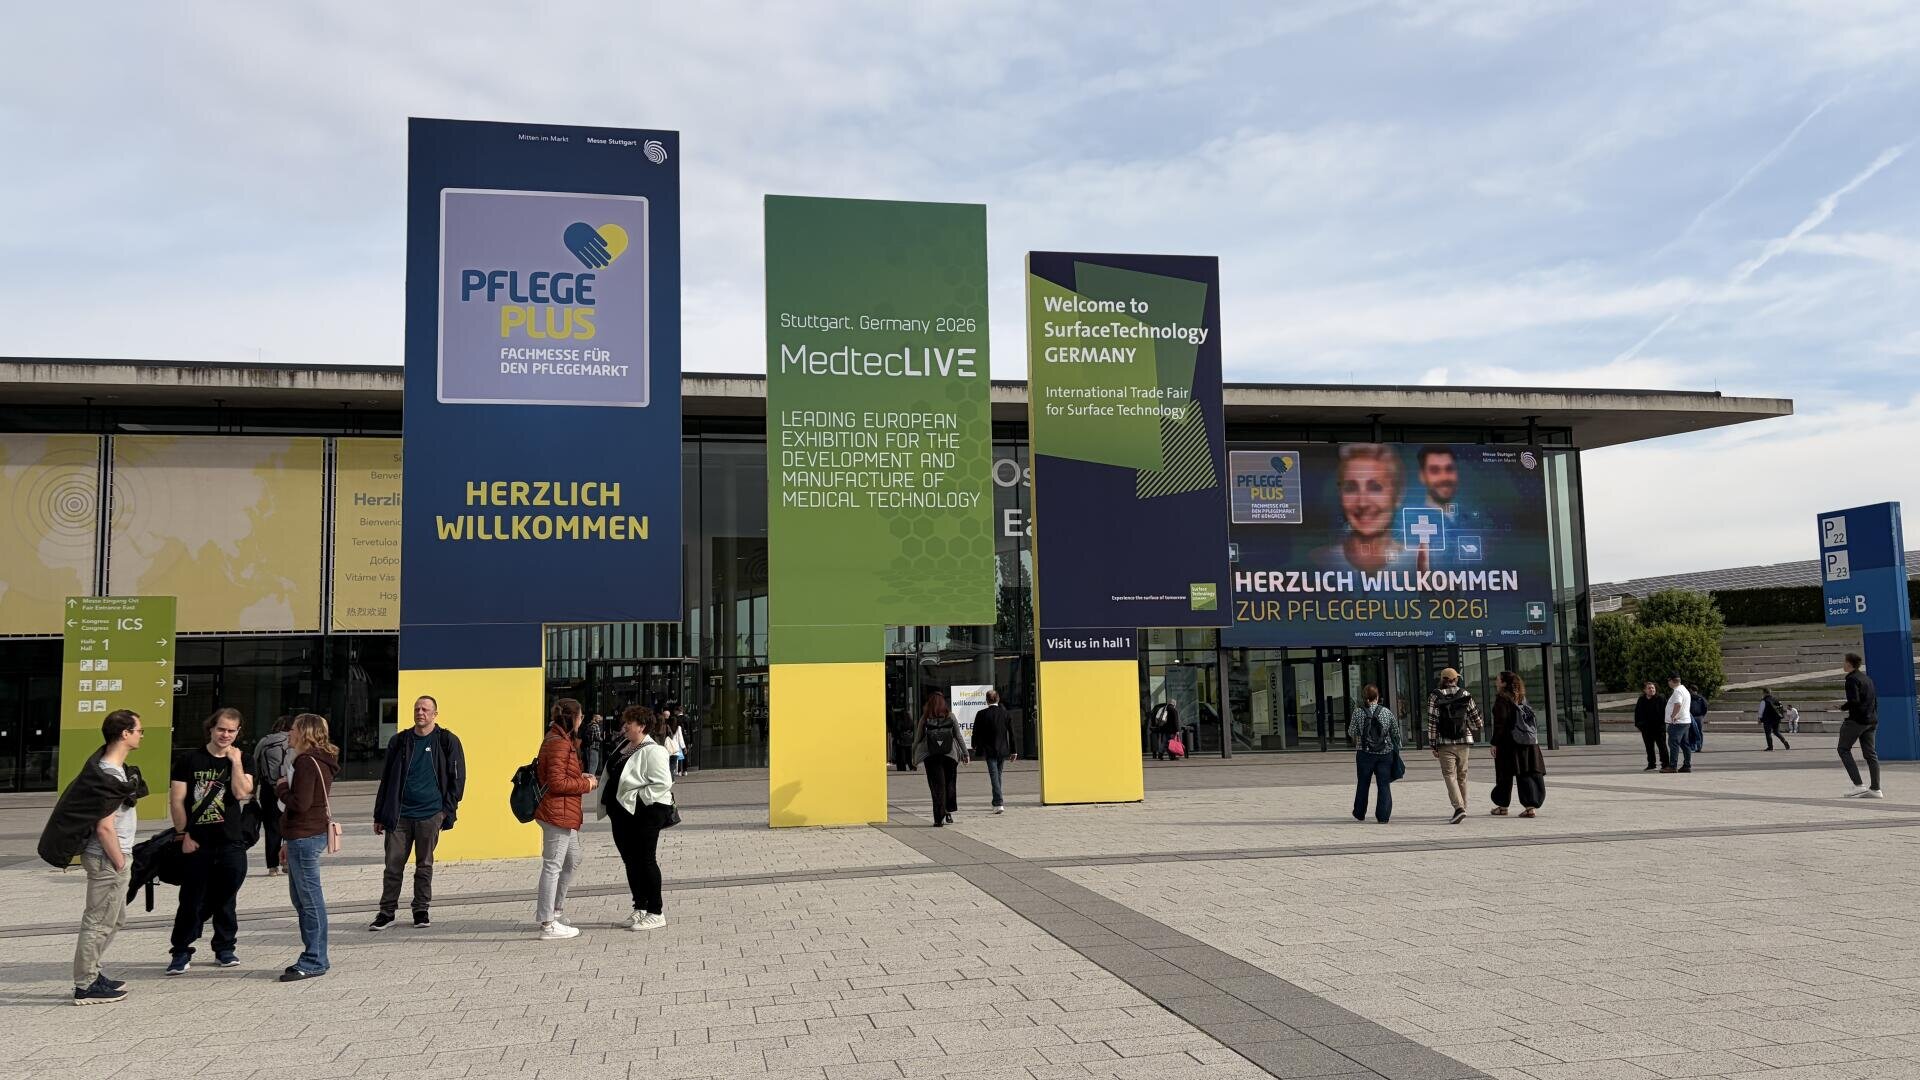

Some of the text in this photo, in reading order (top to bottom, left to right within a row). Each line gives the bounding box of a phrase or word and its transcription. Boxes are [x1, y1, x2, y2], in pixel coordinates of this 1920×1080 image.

[608, 138, 637, 146] Stuttgart
[462, 269, 596, 306] PFLEGE
[1044, 296, 1149, 314] Welcome to
[500, 306, 596, 340] PLUS
[781, 313, 976, 334] Stuttgart, Germany 2026
[1044, 321, 1208, 344] SurfaceTechnology
[500, 348, 610, 362] FACHMESSE FÜR
[781, 344, 976, 377] MedtecLIVE
[1044, 347, 1136, 364] GERMANY
[500, 362, 628, 377] DEN PFLEGEMARKT
[1046, 386, 1189, 399] International Trade Fair
[782, 411, 957, 429] LEADING EUROPEAN
[1046, 404, 1186, 420] for Surface Technology
[782, 431, 960, 448] EXHIBITION FOR THE
[782, 452, 956, 468] DEVELOPMENT AND
[782, 471, 944, 488] MANUFACTURE OF
[1237, 475, 1282, 488] PFLEGE
[466, 481, 620, 506] HERZLICH
[783, 492, 980, 508] MEDICAL TECHNOLOGY
[1250, 488, 1284, 500] PLUS
[436, 516, 648, 540] WILLKOMMEN
[352, 538, 398, 547] Tervetuloa
[1235, 570, 1518, 592] HERZLICH WILLKOMMEN
[1828, 596, 1850, 604] Bereich
[1855, 595, 1866, 612] B
[1236, 598, 1488, 621] ZUR PFLEGEPLUS 2026!
[117, 618, 144, 630] ICS
[102, 639, 109, 650] 1
[1046, 638, 1130, 649] Visit us in hall 1
